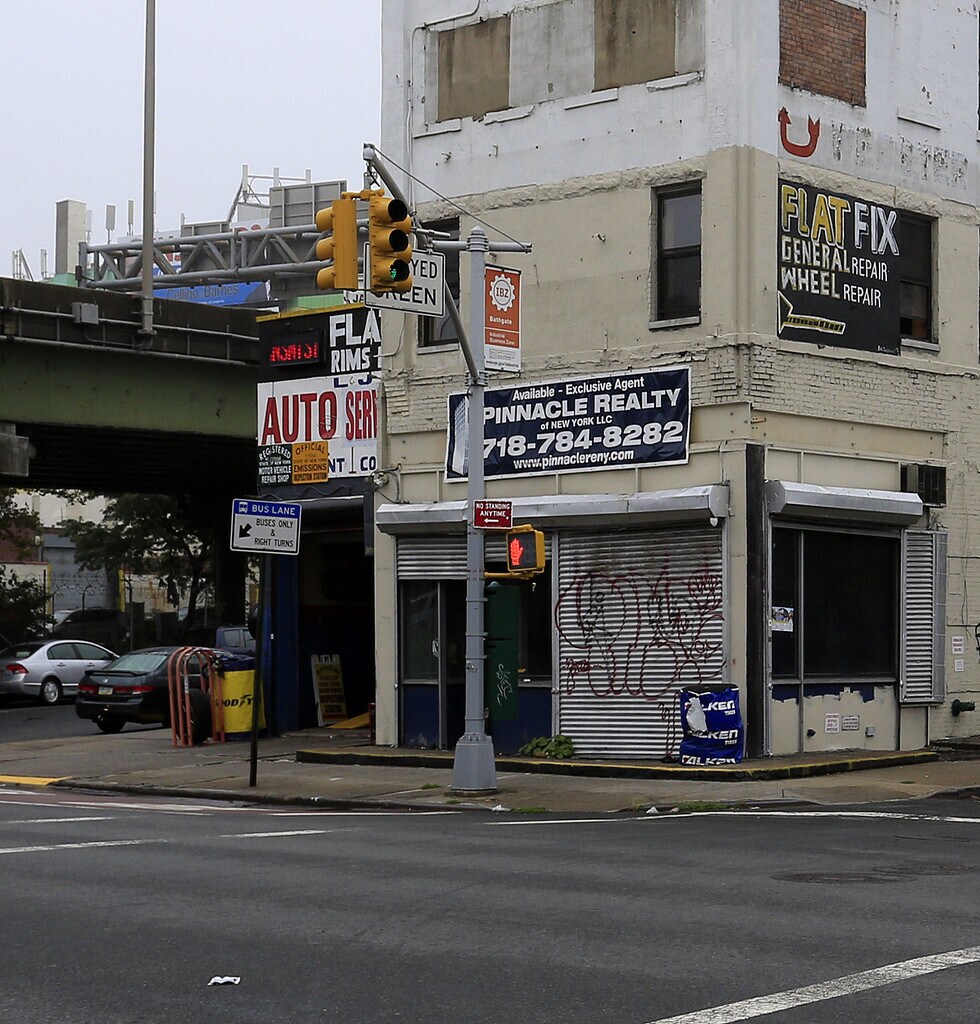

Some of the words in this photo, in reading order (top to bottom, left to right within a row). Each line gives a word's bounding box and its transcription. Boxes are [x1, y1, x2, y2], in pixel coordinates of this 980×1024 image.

[781, 184, 851, 250] FLAT
[854, 201, 900, 255] FIX
[781, 235, 851, 273] GENERAL
[851, 256, 888, 282] REPAIR
[411, 259, 438, 279] YED
[496, 287, 509, 298] IBZ
[781, 266, 840, 299] WHEEL
[843, 283, 881, 308] REPAIR
[489, 315, 512, 325] Bathgate
[329, 309, 381, 348] FLA
[331, 347, 371, 373] RIMS
[512, 385, 555, 402] Available
[565, 380, 612, 396] Exclusive
[614, 376, 645, 392] Agent
[483, 397, 588, 425] PINNACLE
[594, 388, 682, 414] REALTY
[261, 391, 338, 445] AUTO
[540, 422, 550, 431] of
[551, 420, 571, 430] NEW
[572, 416, 594, 427] YORK
[596, 415, 613, 425] LLC
[483, 420, 684, 459] 718-784-8282
[259, 445, 292, 461] REGISTERED
[295, 442, 325, 455] OFFICIAL
[294, 463, 327, 472] EMISSIONS
[328, 457, 345, 473] NT
[513, 449, 634, 470] www.pinnaclereny.com
[277, 474, 290, 483] SHOP
[252, 504, 269, 513] BUS
[272, 506, 296, 515] LANE
[256, 518, 276, 527] BUSES
[279, 520, 294, 528] ONLY
[270, 529, 275, 537] &
[254, 538, 271, 546] RIGHT
[274, 539, 294, 547] TURNS
